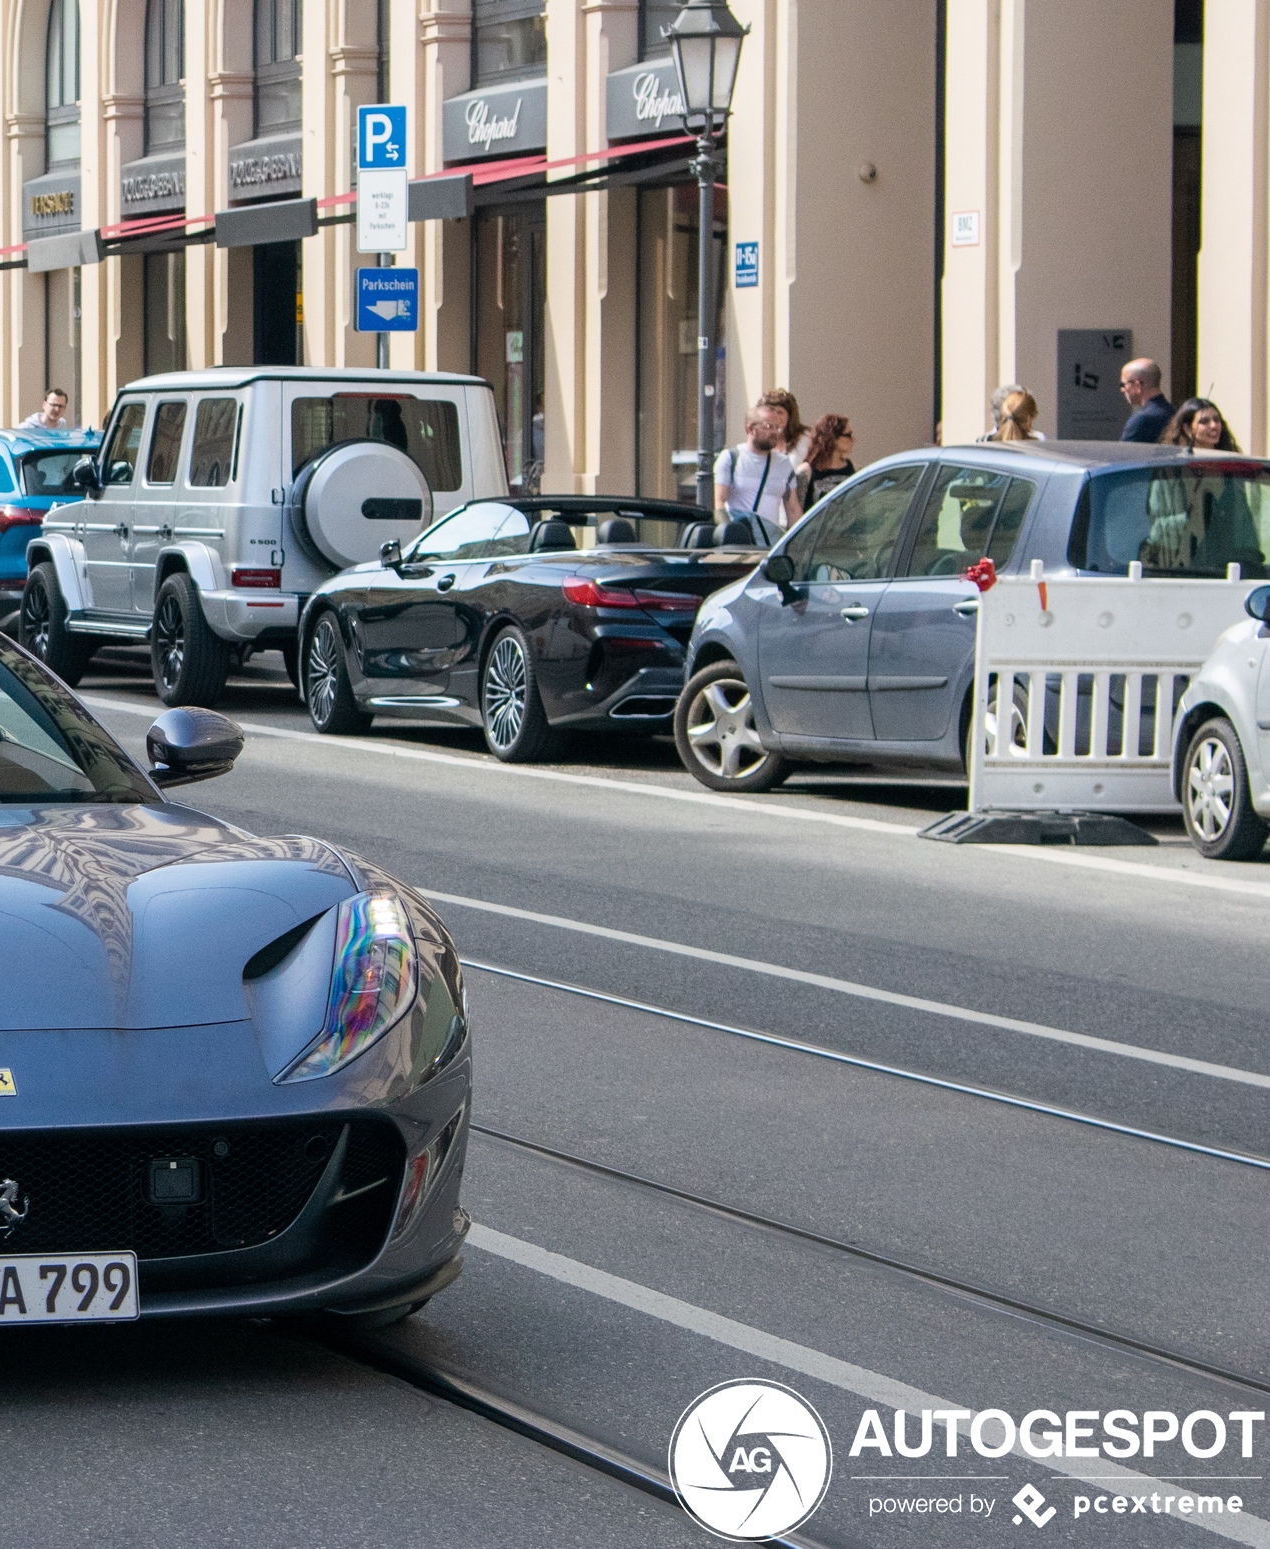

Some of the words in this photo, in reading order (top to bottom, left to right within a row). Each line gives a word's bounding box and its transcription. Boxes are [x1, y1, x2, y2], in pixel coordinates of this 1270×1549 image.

[465, 98, 522, 151] Chopard
[633, 72, 686, 128] Chopar
[365, 113, 393, 162] P
[362, 278, 415, 291] Parkschein
[39, 1262, 131, 1313] 799
